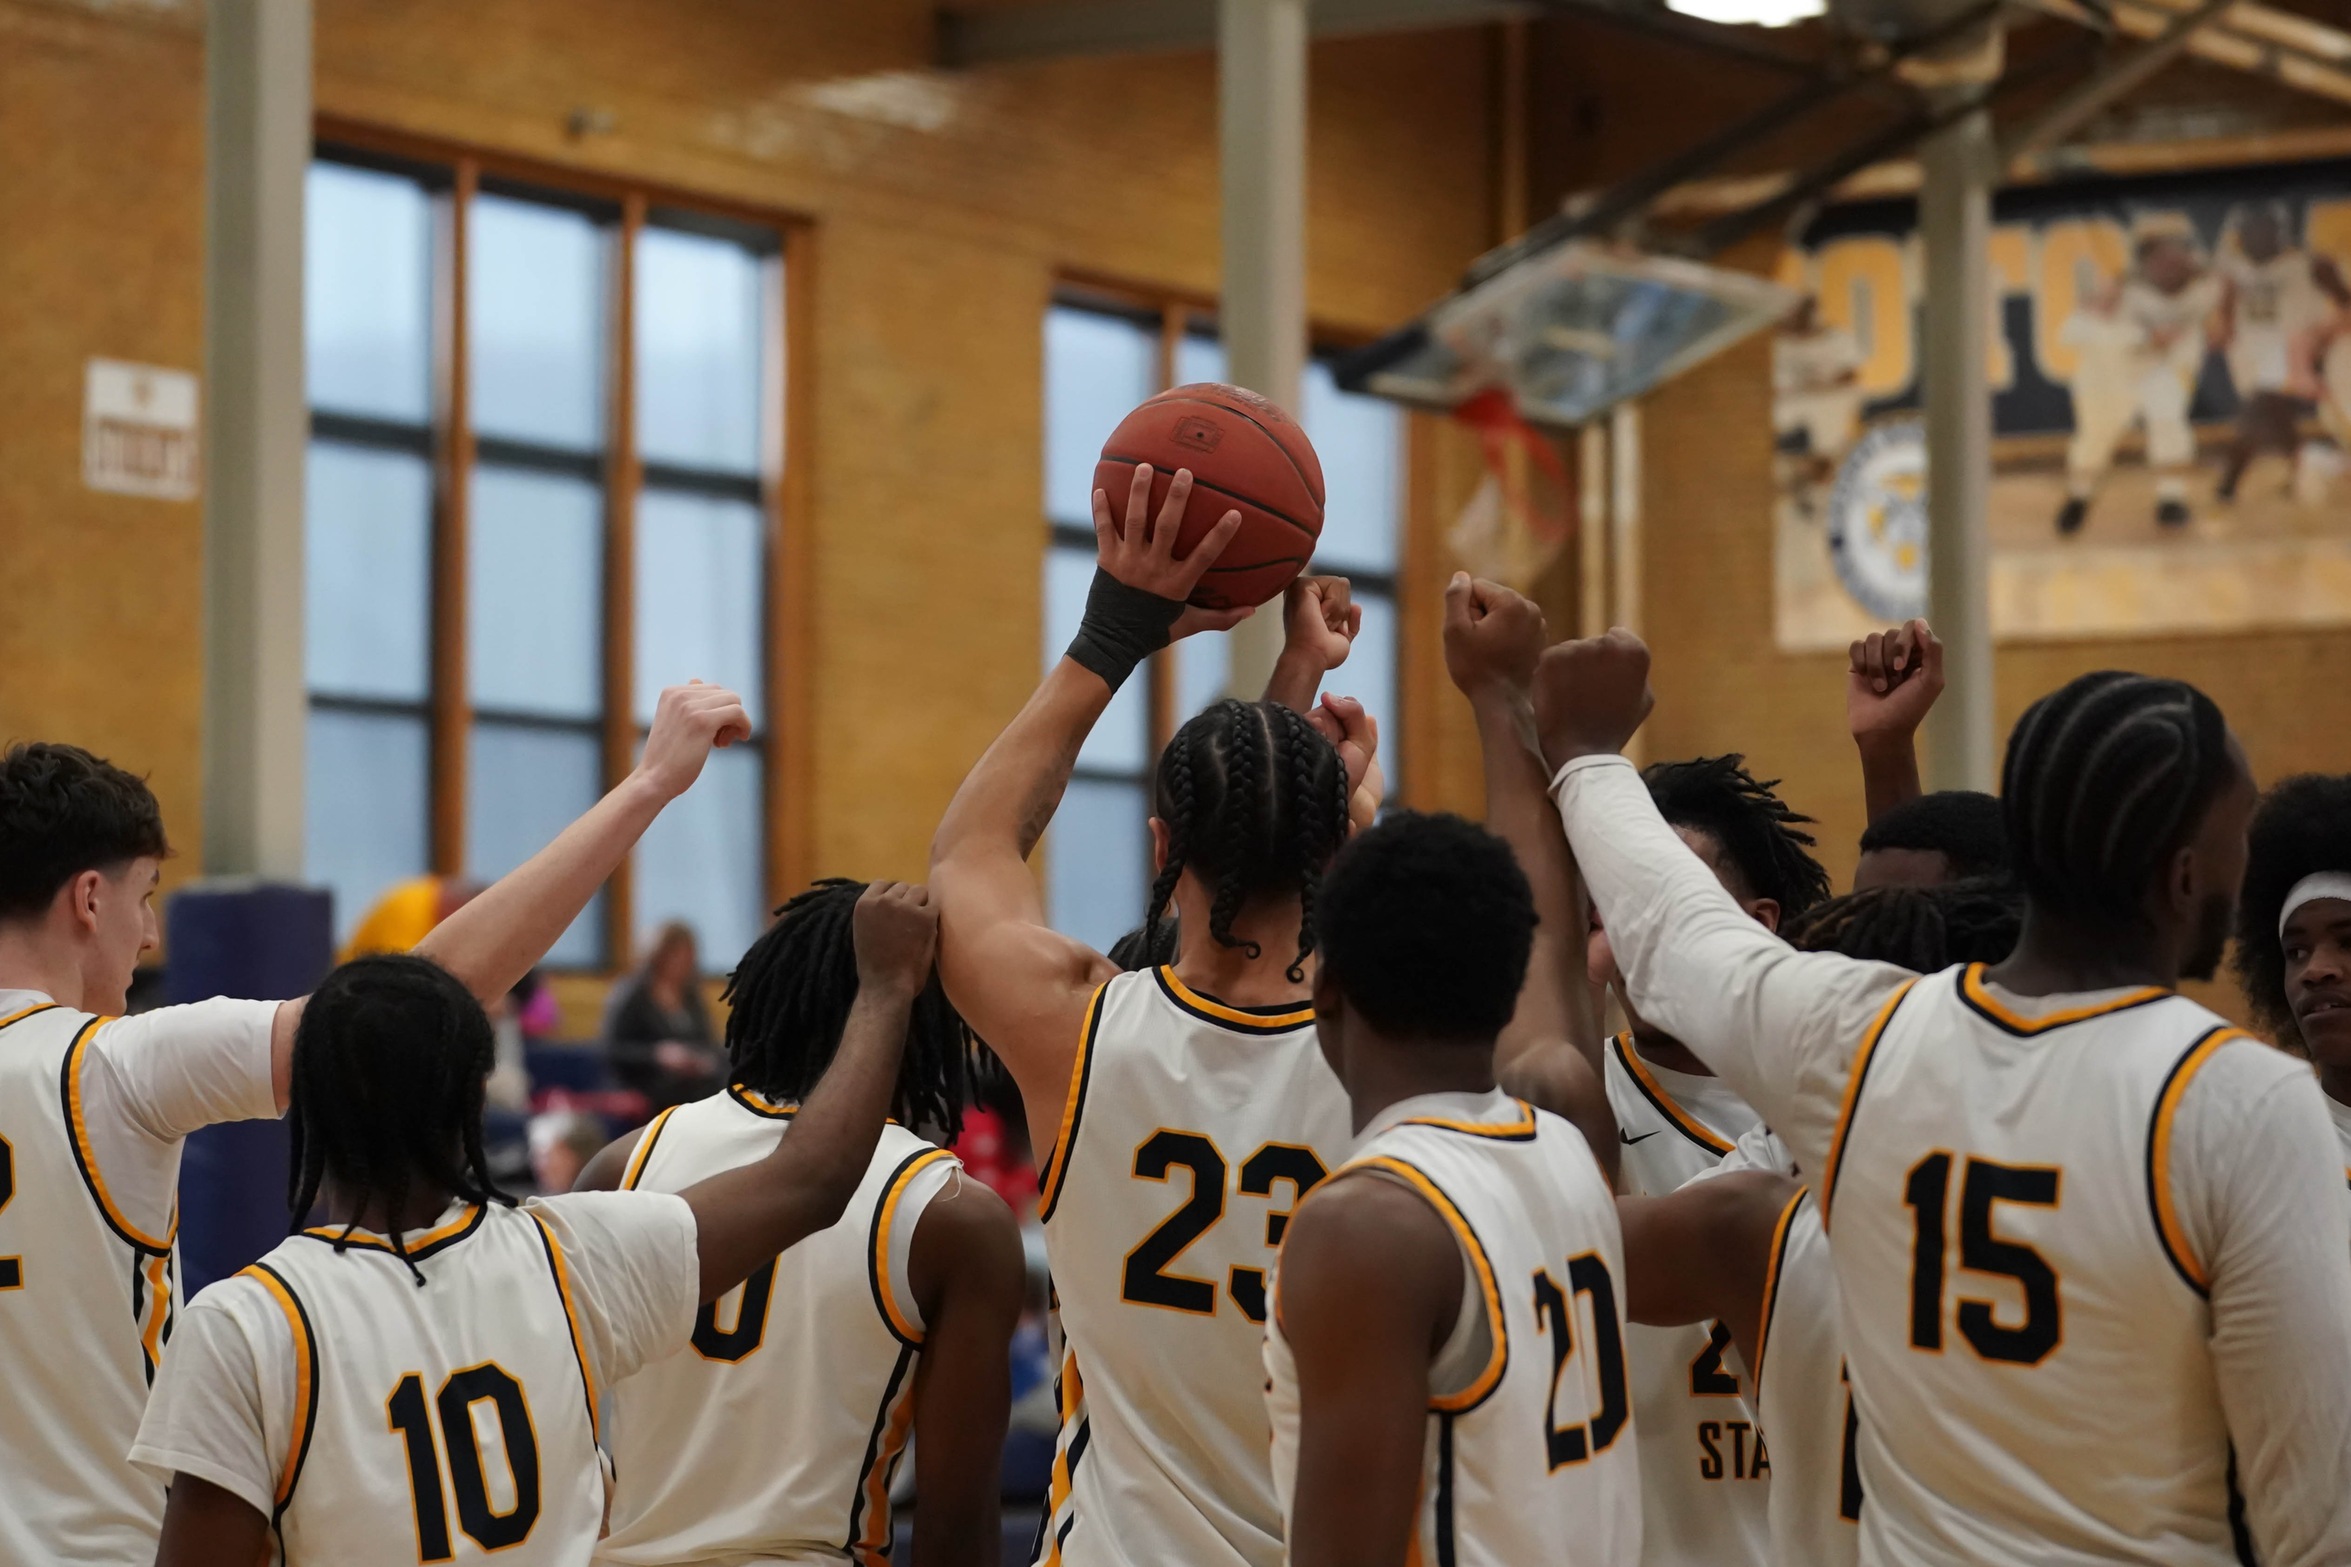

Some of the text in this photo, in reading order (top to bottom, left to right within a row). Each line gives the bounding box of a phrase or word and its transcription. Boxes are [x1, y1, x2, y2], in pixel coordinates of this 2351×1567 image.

[1119, 1127, 1331, 1325] 23
[1904, 1147, 2062, 1368] 15
[384, 1359, 541, 1566] 10
